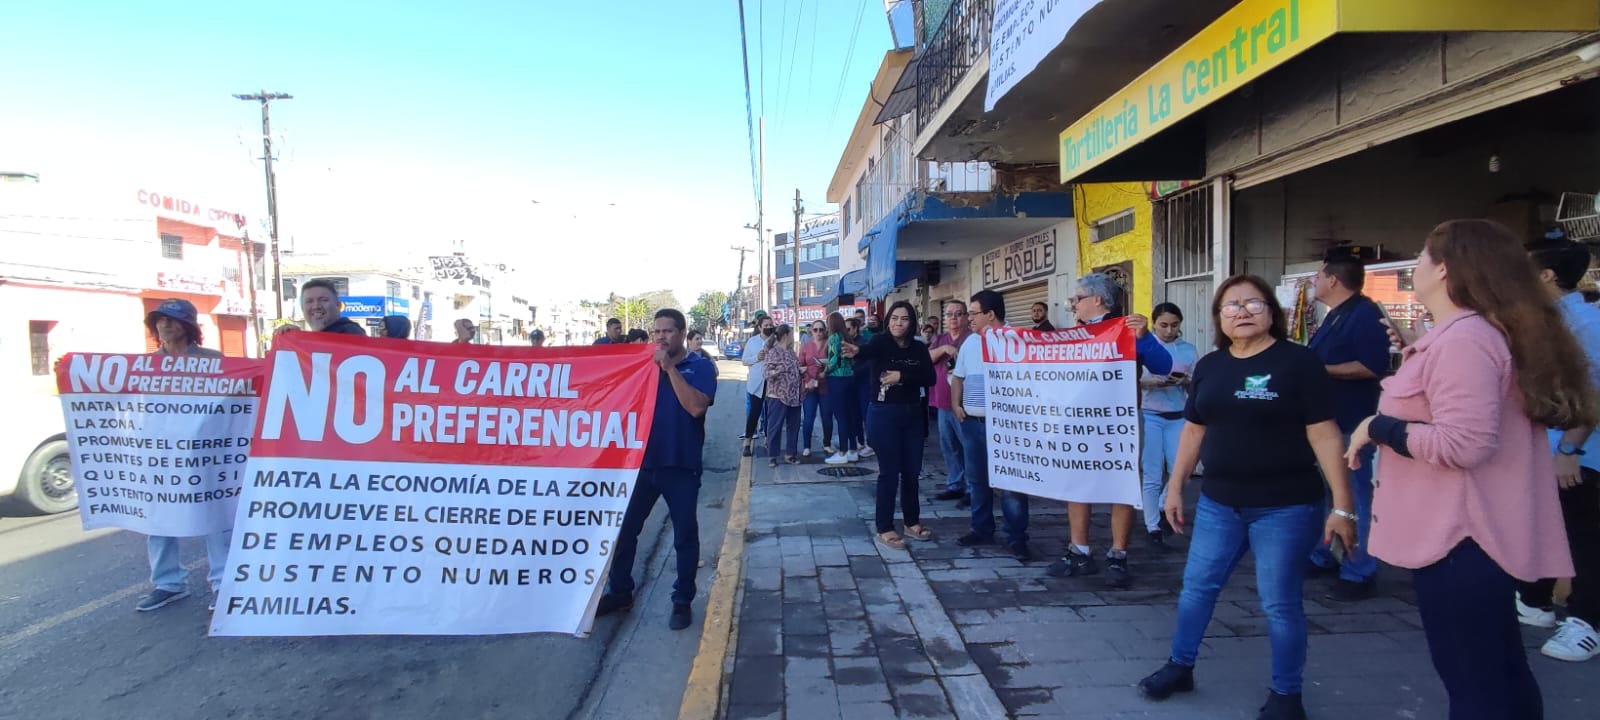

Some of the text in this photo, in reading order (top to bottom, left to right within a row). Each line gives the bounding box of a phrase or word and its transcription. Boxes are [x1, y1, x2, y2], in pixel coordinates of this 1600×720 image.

[1063, 0, 1299, 173] Tortillería La Central
[137, 189, 201, 216] COMIDA
[985, 242, 1053, 286] EL ROBLE
[345, 303, 381, 313] moderna
[1022, 327, 1095, 343] AL CARRIL
[985, 328, 1026, 363] NO
[1028, 342, 1123, 360] PREFERENCIAL
[69, 354, 127, 393] NO
[132, 356, 223, 374] AL CARRIL
[394, 358, 578, 399] AL CARRIL
[988, 368, 1123, 381] MATA LA ECONOMÍA DE
[128, 375, 256, 395] PREFERENCIAL
[990, 386, 1000, 395] LA
[1002, 387, 1032, 398] ZONA
[261, 350, 386, 444] NO
[71, 401, 252, 415] MATA LA ECONOMÍA DE
[991, 401, 1135, 418] PROMUEVE EL CIERRE DE
[75, 419, 96, 429] LA
[100, 419, 135, 430] ZONA
[391, 402, 643, 449] PREFERENCIAL
[992, 418, 1038, 432] FUENTES
[1043, 423, 1059, 434] DE
[78, 436, 253, 450] PROMUEVE EL CIERRE D
[993, 433, 1089, 453] QUEDANDO
[81, 453, 247, 468] FUENTES DE EMPLEO
[994, 449, 1134, 471] SUSTENTO NUMEROSA
[84, 470, 238, 486] QUEDANDO SI
[994, 465, 1043, 482] FAMILIAS.
[254, 470, 627, 498] MATA LA ECONOMÍA DE LA ZONA
[87, 487, 242, 503] SUSTENTO NUMEROSA
[90, 504, 147, 519] FAMILIAS.
[248, 501, 624, 527] PROMUEVE EL CIERRE DE FUENTE
[242, 532, 278, 550] DE
[289, 533, 424, 553] EMPLEOS
[435, 537, 589, 556] QUEDANDO
[234, 564, 595, 585] SUSTENTO NUMEROS
[227, 597, 356, 615] FAMILIAS.
